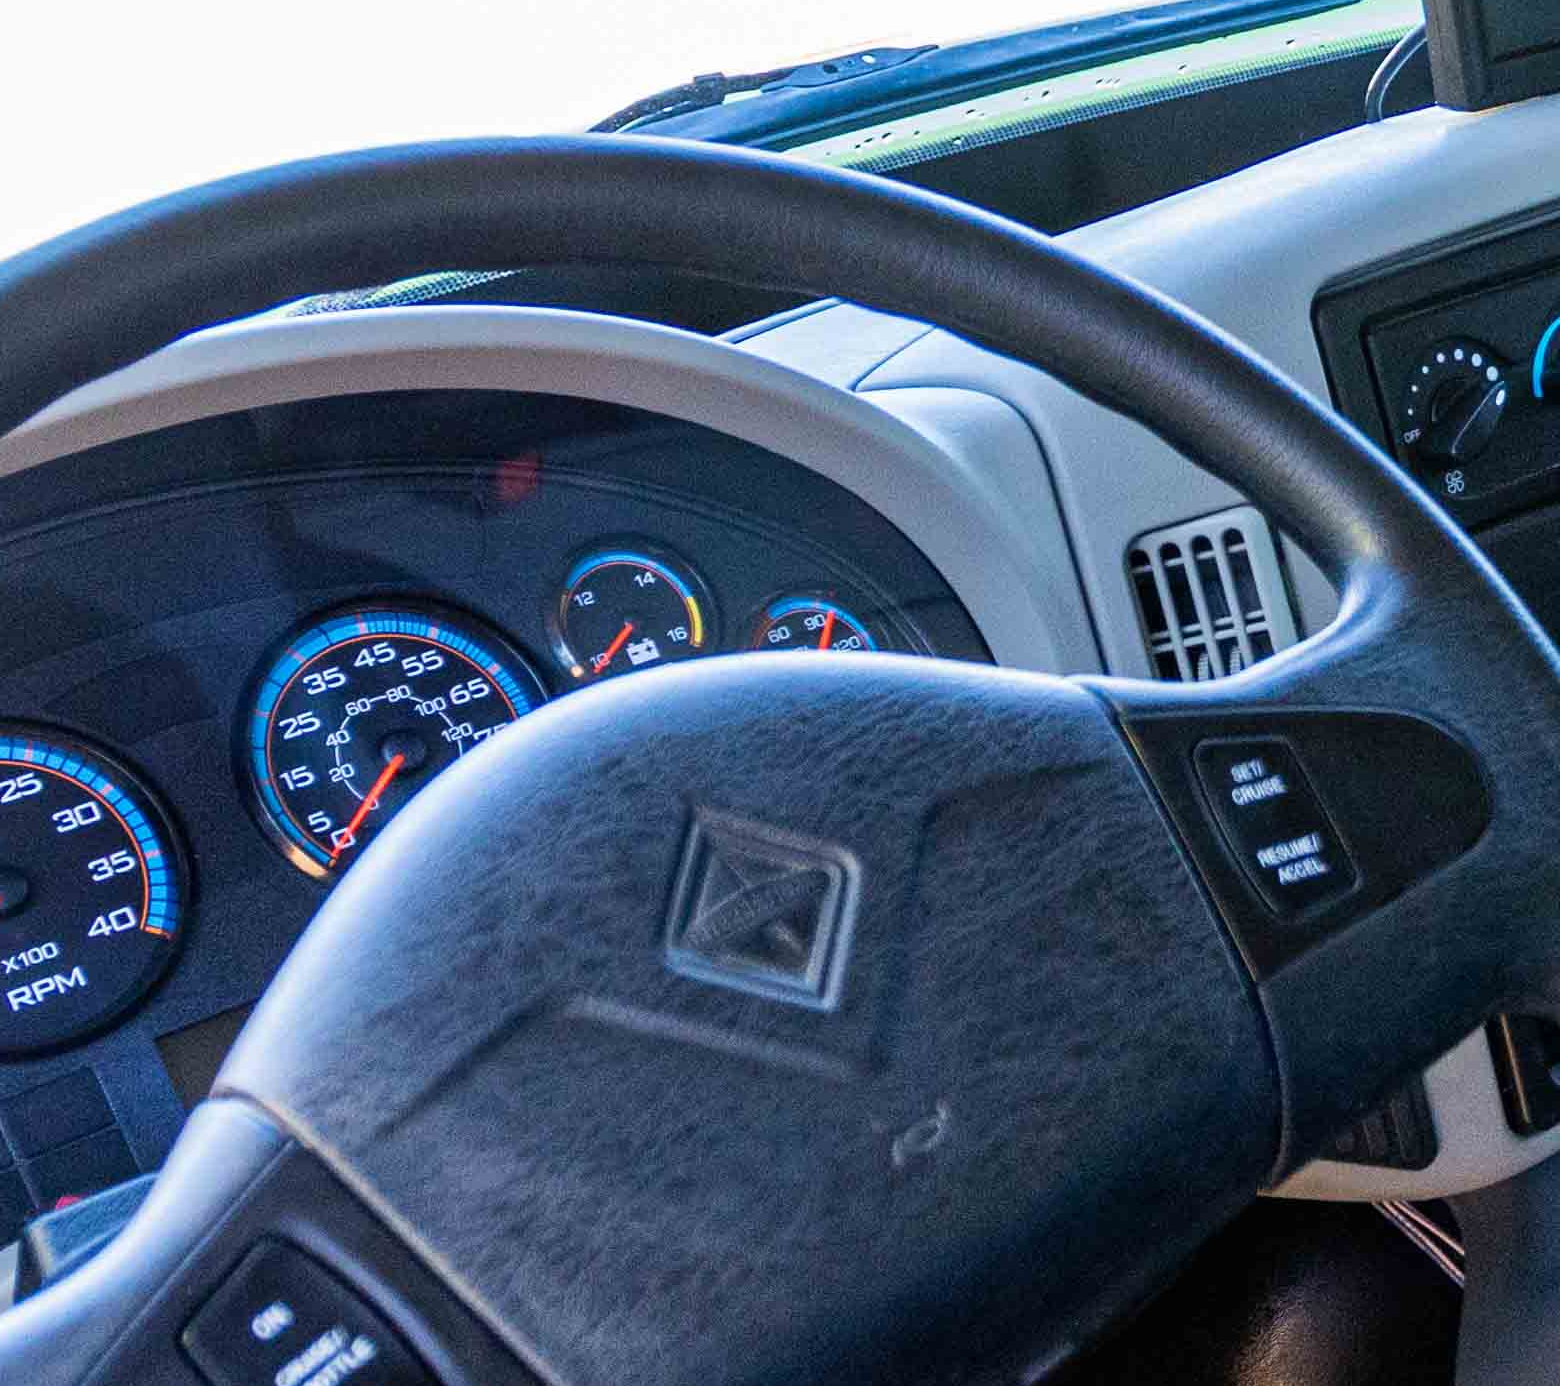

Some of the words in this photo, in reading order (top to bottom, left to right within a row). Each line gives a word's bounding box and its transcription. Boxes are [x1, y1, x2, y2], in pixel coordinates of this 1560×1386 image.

[1403, 428, 1422, 445] OFF
[633, 571, 657, 589] 14
[574, 591, 595, 608] 12
[666, 625, 688, 643] 16
[767, 626, 791, 644] 60
[353, 642, 397, 670] 45
[401, 650, 444, 679] 55
[302, 666, 347, 696] 35
[449, 677, 490, 706] 65
[386, 684, 412, 703] 80
[345, 698, 371, 717] 60
[414, 696, 446, 717] 100
[278, 711, 321, 740] 25
[441, 723, 473, 743] 120
[325, 729, 351, 748] 40
[279, 765, 315, 791] 15
[328, 763, 355, 783] 20
[51, 801, 101, 833] 30
[307, 810, 333, 834] 5
[87, 850, 137, 882] 35
[87, 906, 137, 938] 40
[5, 966, 89, 1012] RPM
[251, 1299, 294, 1340] ON
